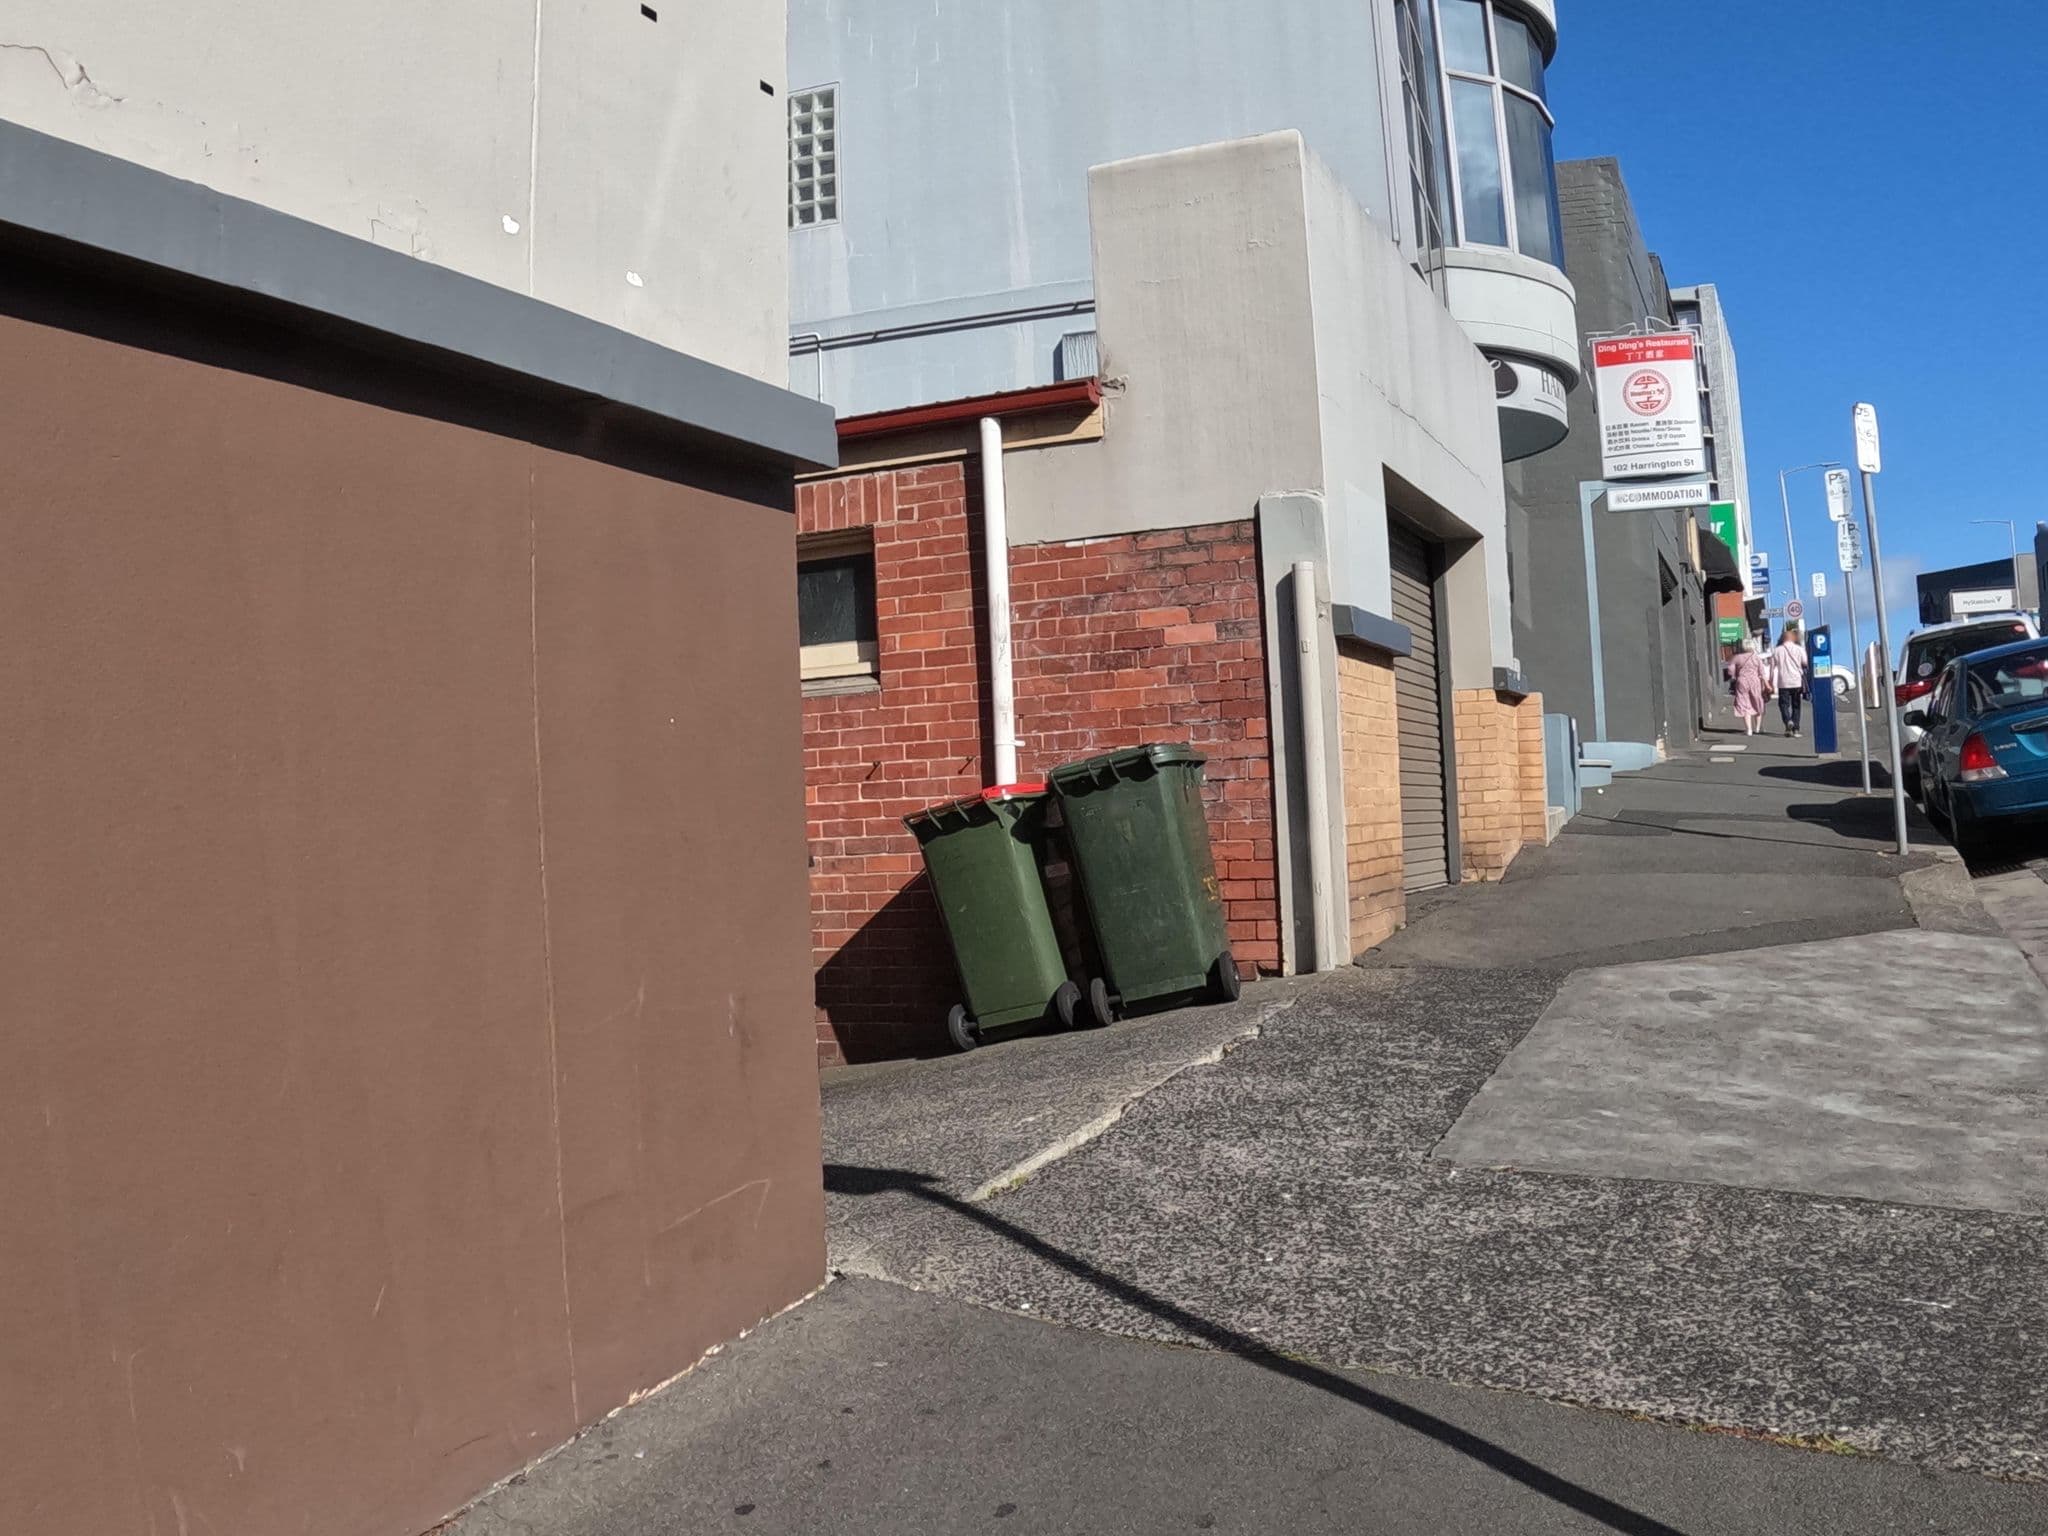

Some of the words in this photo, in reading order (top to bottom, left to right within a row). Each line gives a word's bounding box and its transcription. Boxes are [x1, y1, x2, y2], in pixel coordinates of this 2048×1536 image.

[1618, 341, 1644, 350] Ding's
[1645, 339, 1689, 347] Restaurant
[1613, 464, 1628, 472] 102
[1630, 459, 1682, 470] Harrington
[1683, 458, 1695, 466] St
[1615, 488, 1703, 503] ACCOMMODATION
[1790, 605, 1800, 613] 40
[1817, 634, 1826, 648] P
